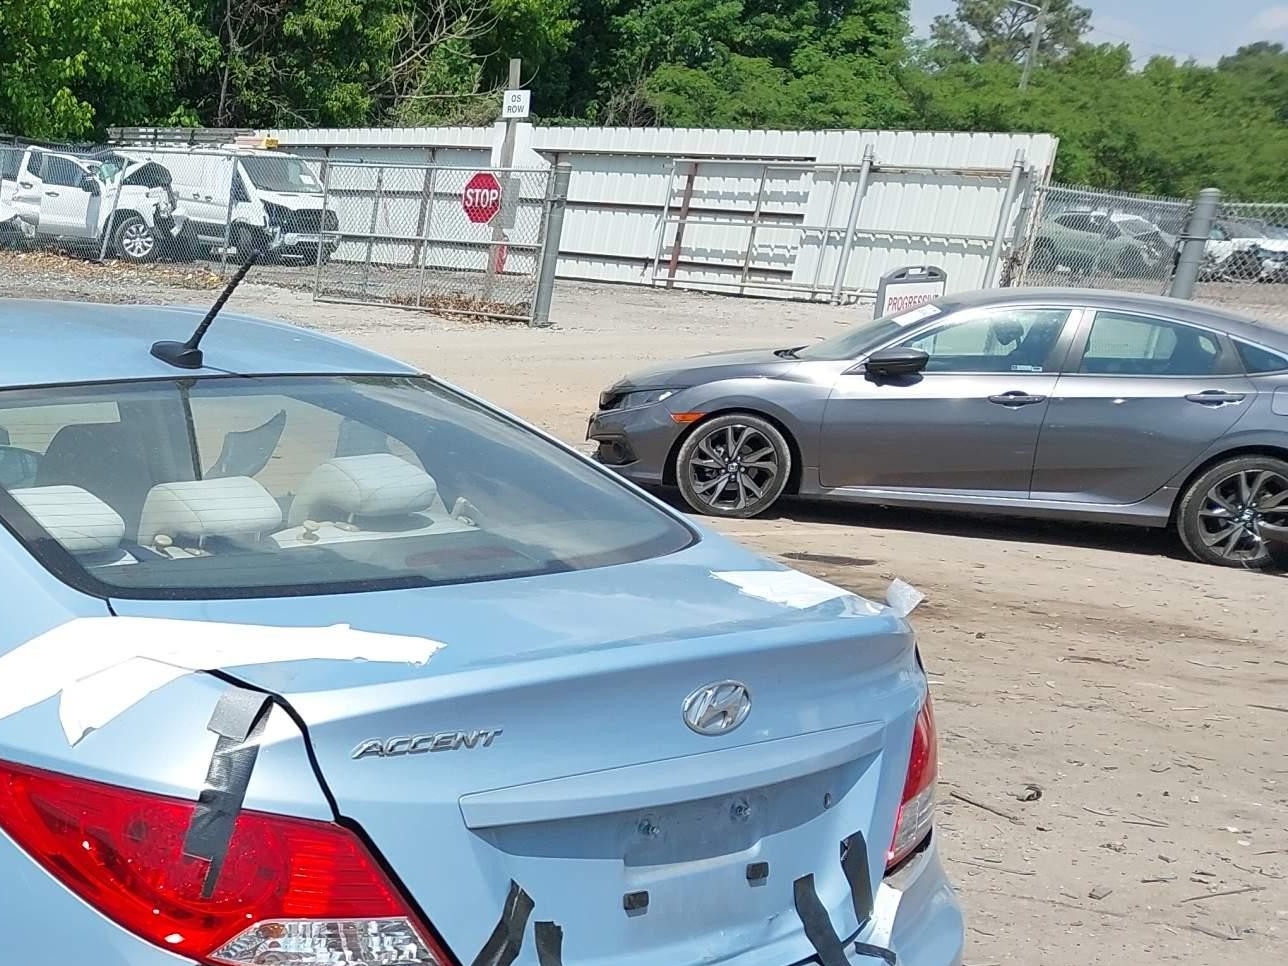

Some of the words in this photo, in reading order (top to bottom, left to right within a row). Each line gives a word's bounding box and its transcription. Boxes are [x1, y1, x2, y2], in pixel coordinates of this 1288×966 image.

[507, 105, 525, 114] ROW
[465, 188, 499, 208] STOP
[352, 727, 504, 760] ACCENT
